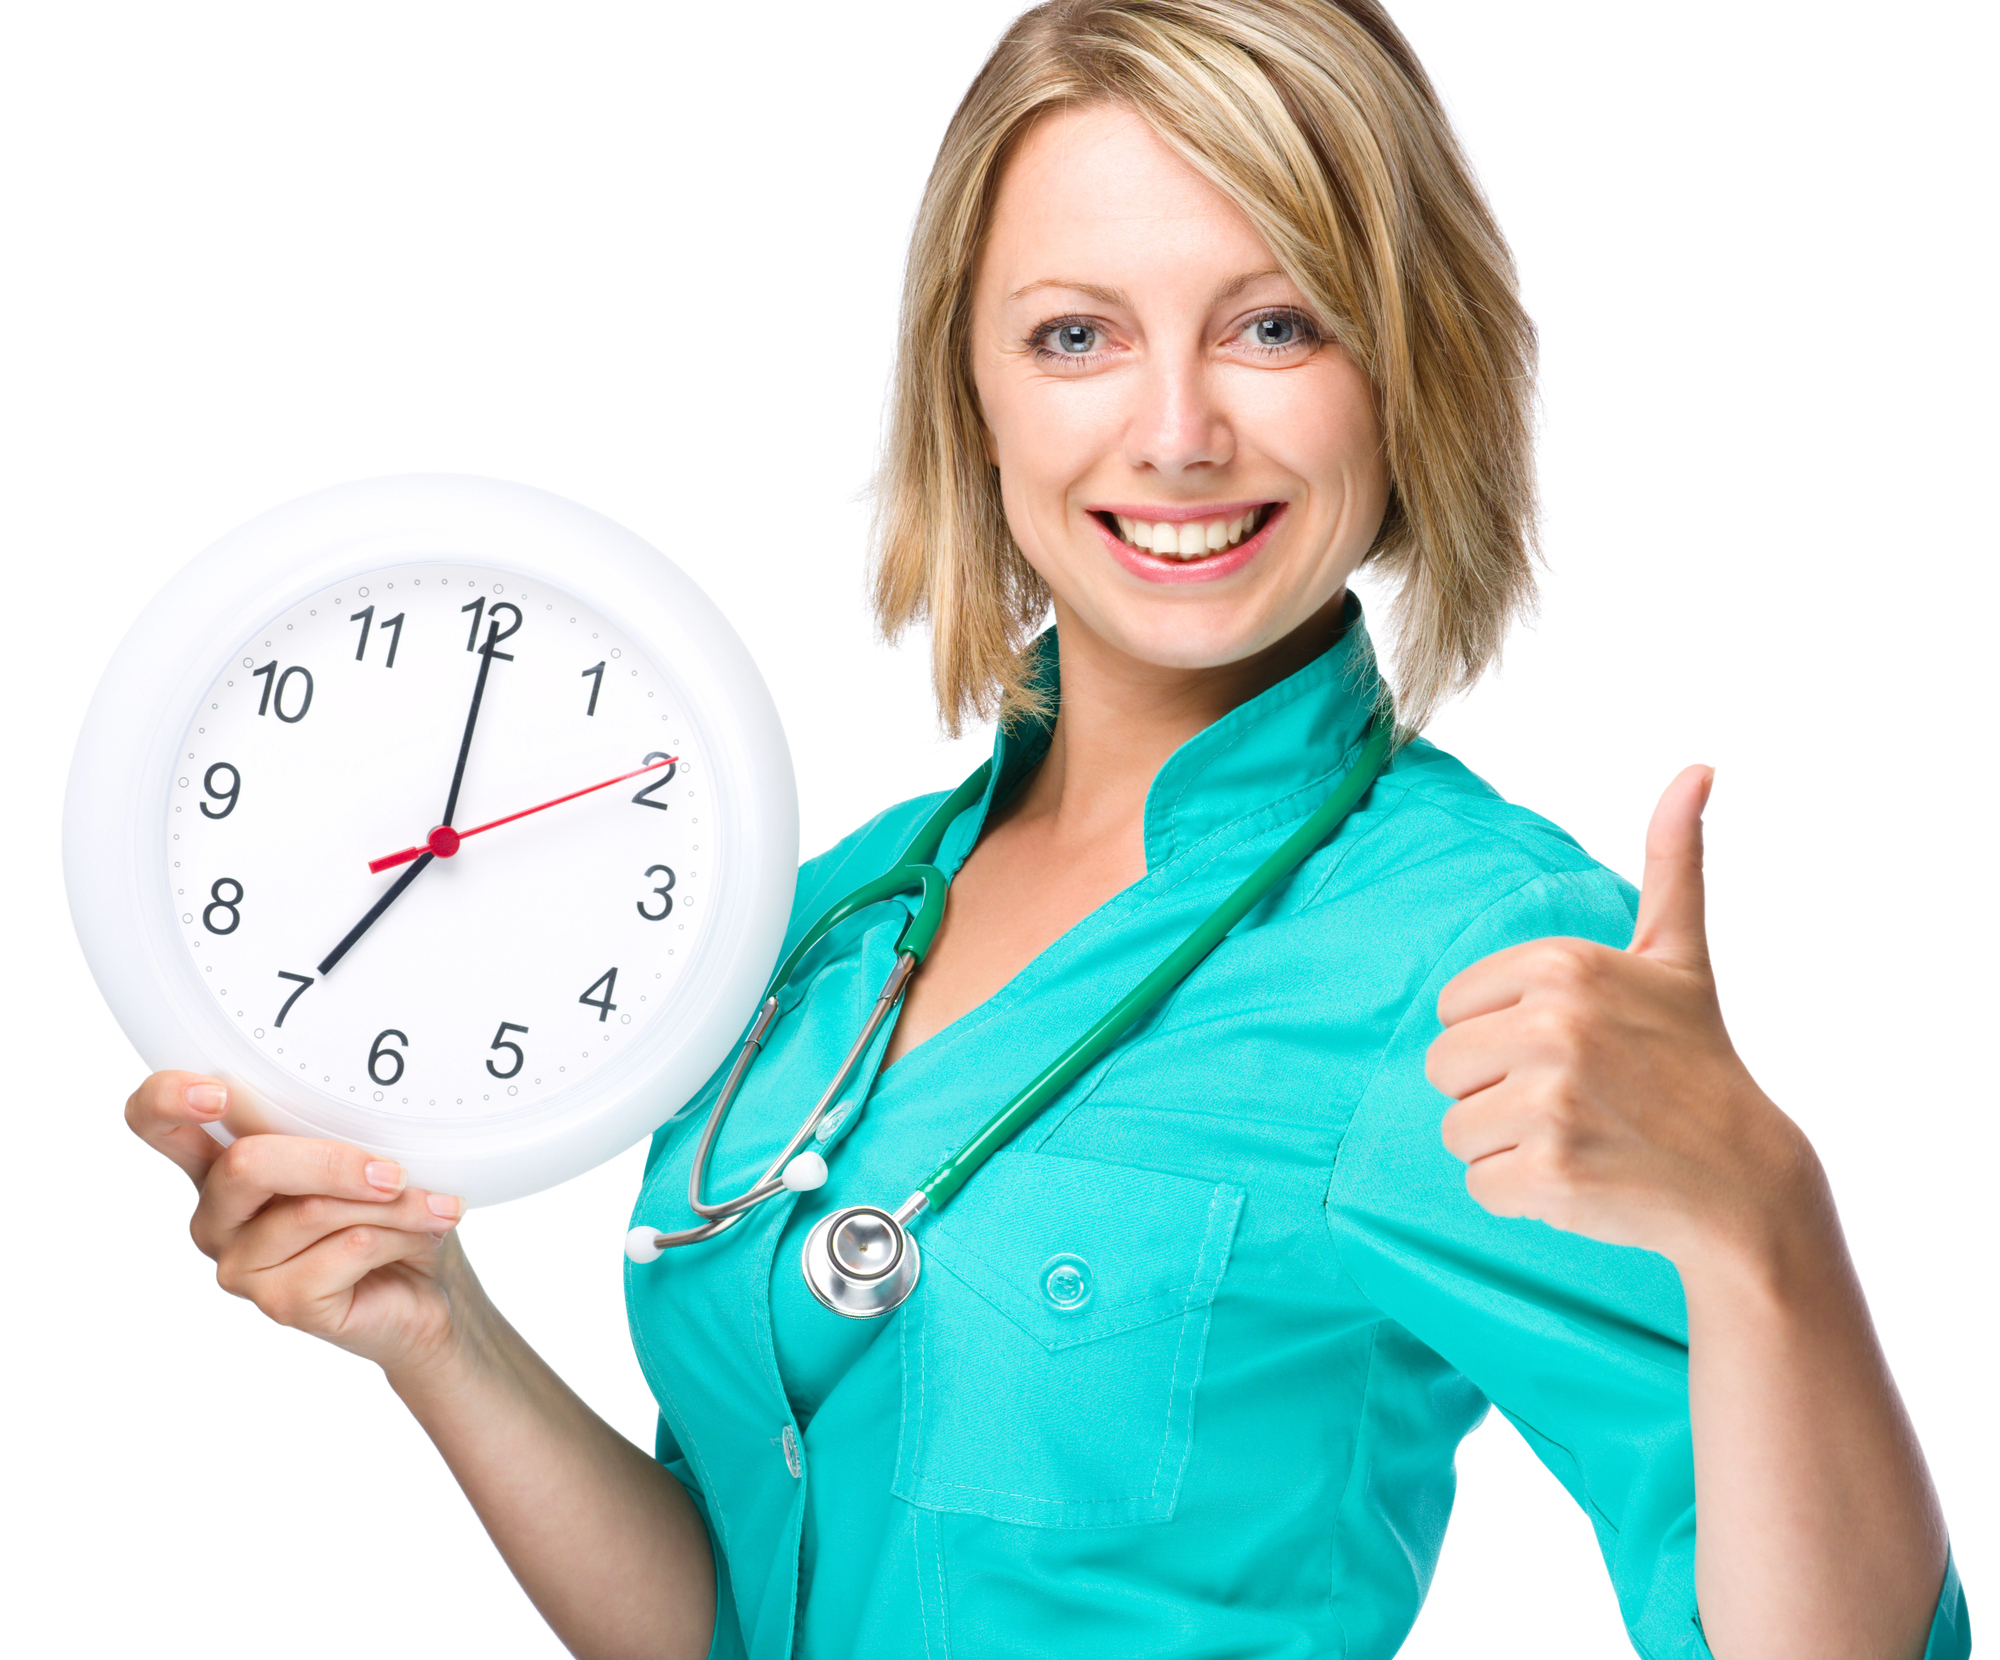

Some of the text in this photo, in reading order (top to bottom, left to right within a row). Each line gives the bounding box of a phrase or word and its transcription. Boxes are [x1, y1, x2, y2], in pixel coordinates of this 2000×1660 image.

[350, 605, 405, 669] 11
[461, 596, 523, 662] 12
[252, 660, 314, 724] 10
[581, 661, 606, 717] 1
[199, 762, 241, 820] 9
[631, 751, 677, 811] 2
[202, 877, 244, 936] 8
[636, 864, 676, 921] 3
[274, 970, 315, 1028] 7
[578, 967, 618, 1022] 4
[367, 1029, 409, 1086] 6
[486, 1021, 529, 1080] 5
